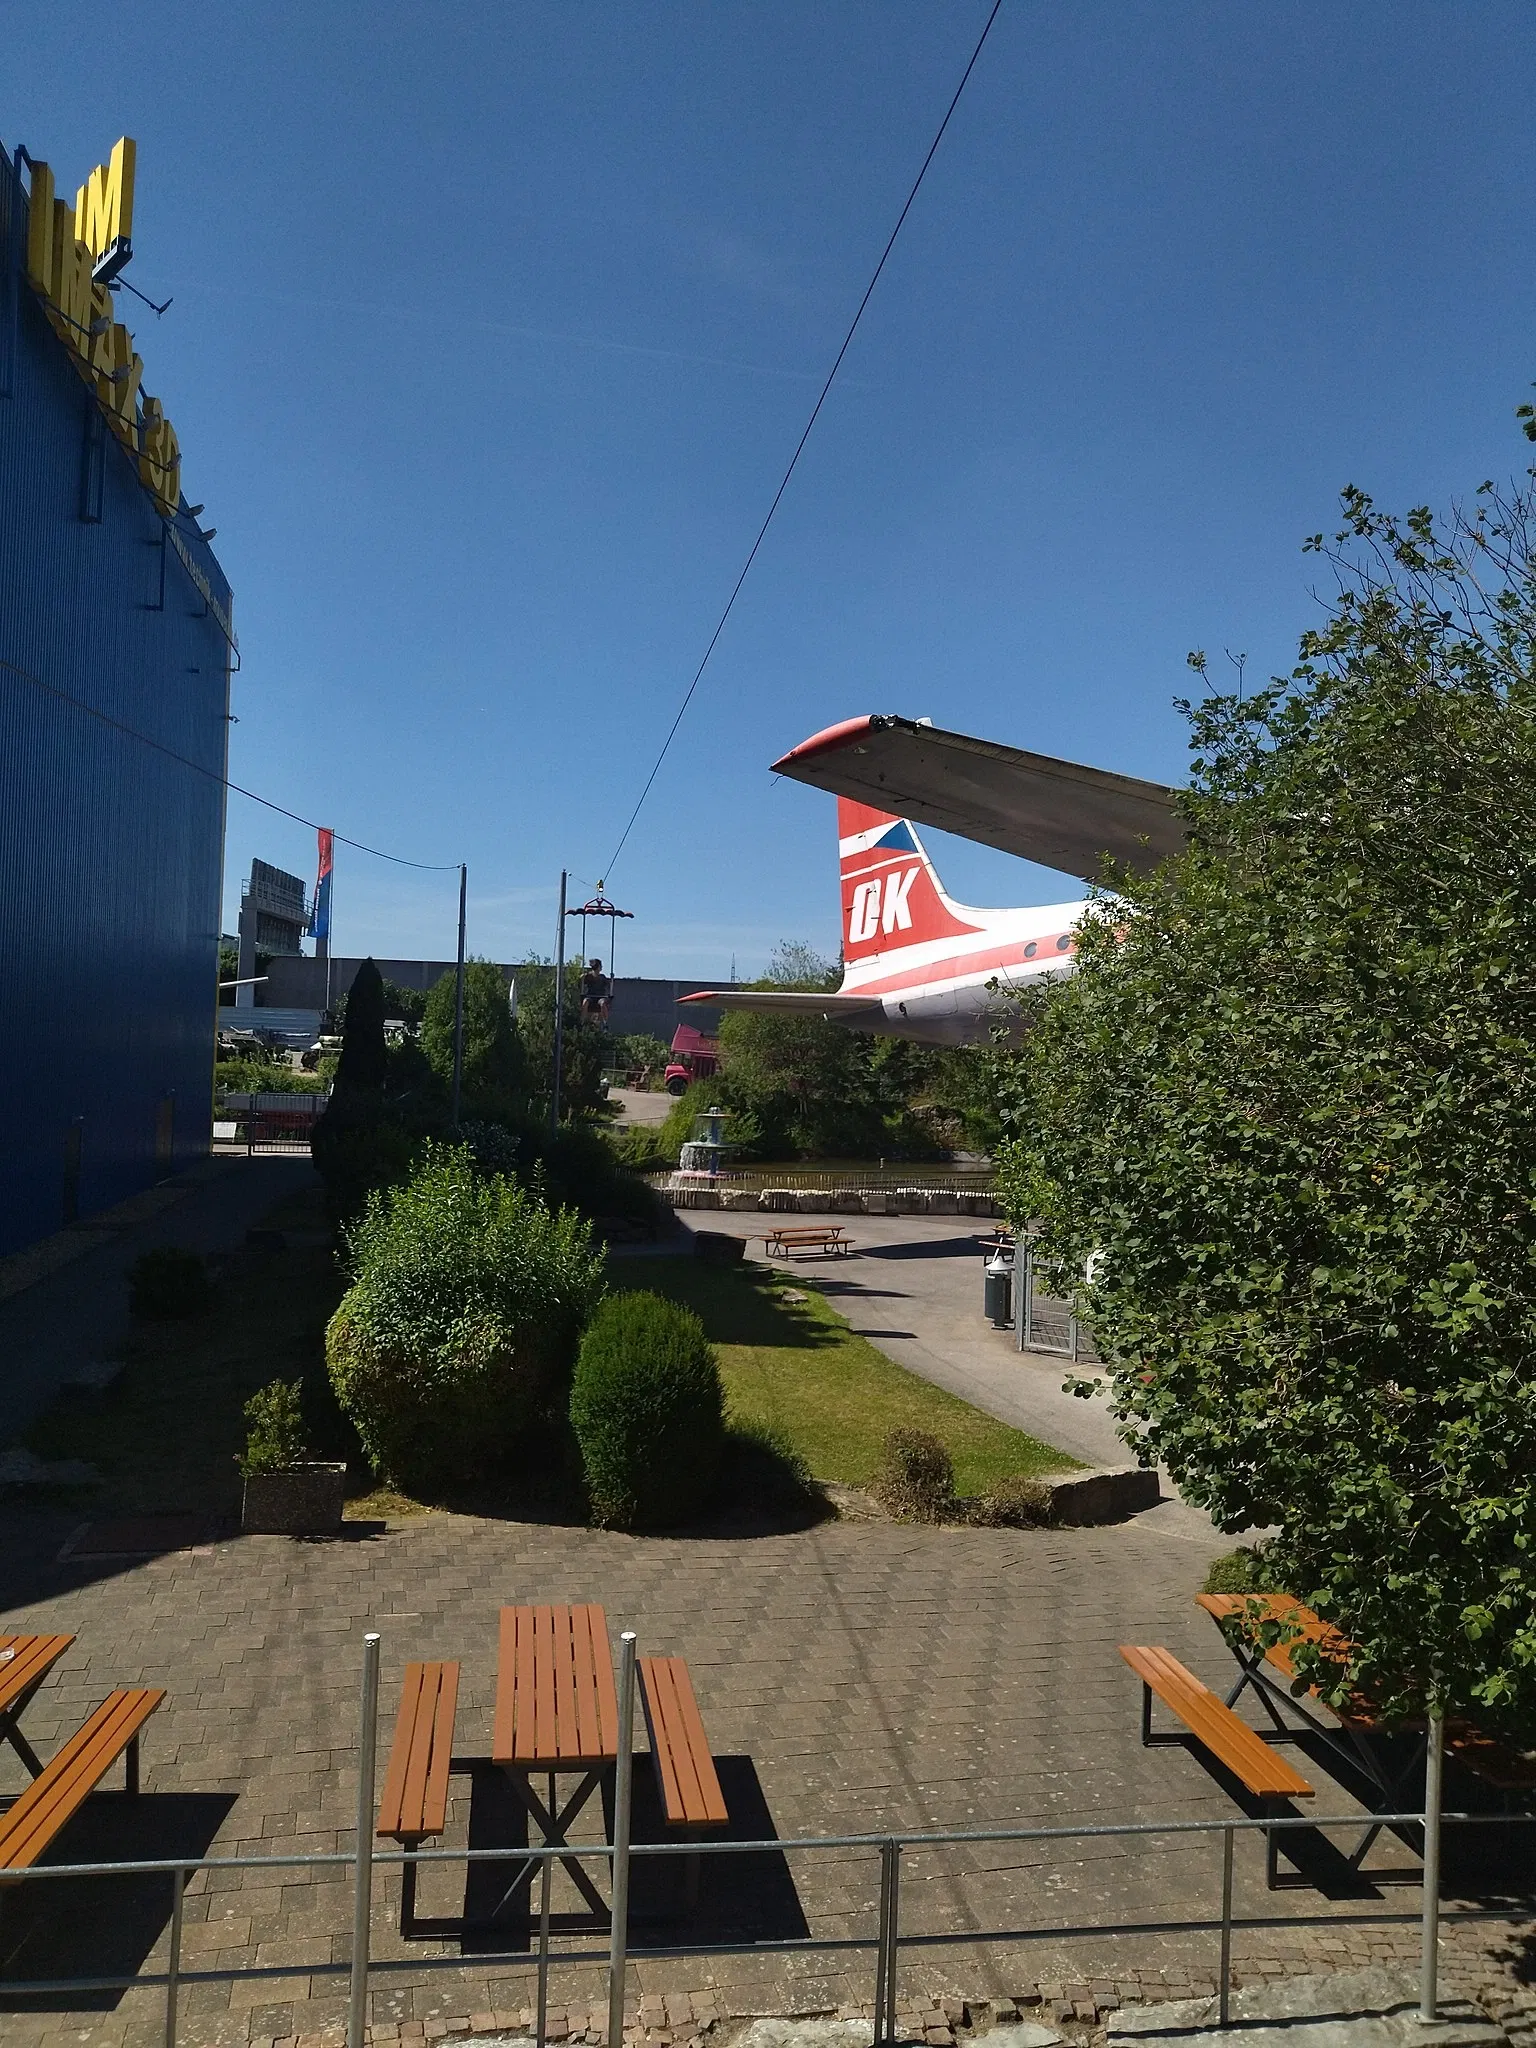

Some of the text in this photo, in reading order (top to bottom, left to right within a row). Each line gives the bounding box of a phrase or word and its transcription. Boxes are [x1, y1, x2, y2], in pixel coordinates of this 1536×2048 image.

[30, 161, 181, 517] IMAX 3D
[849, 866, 921, 944] OK
